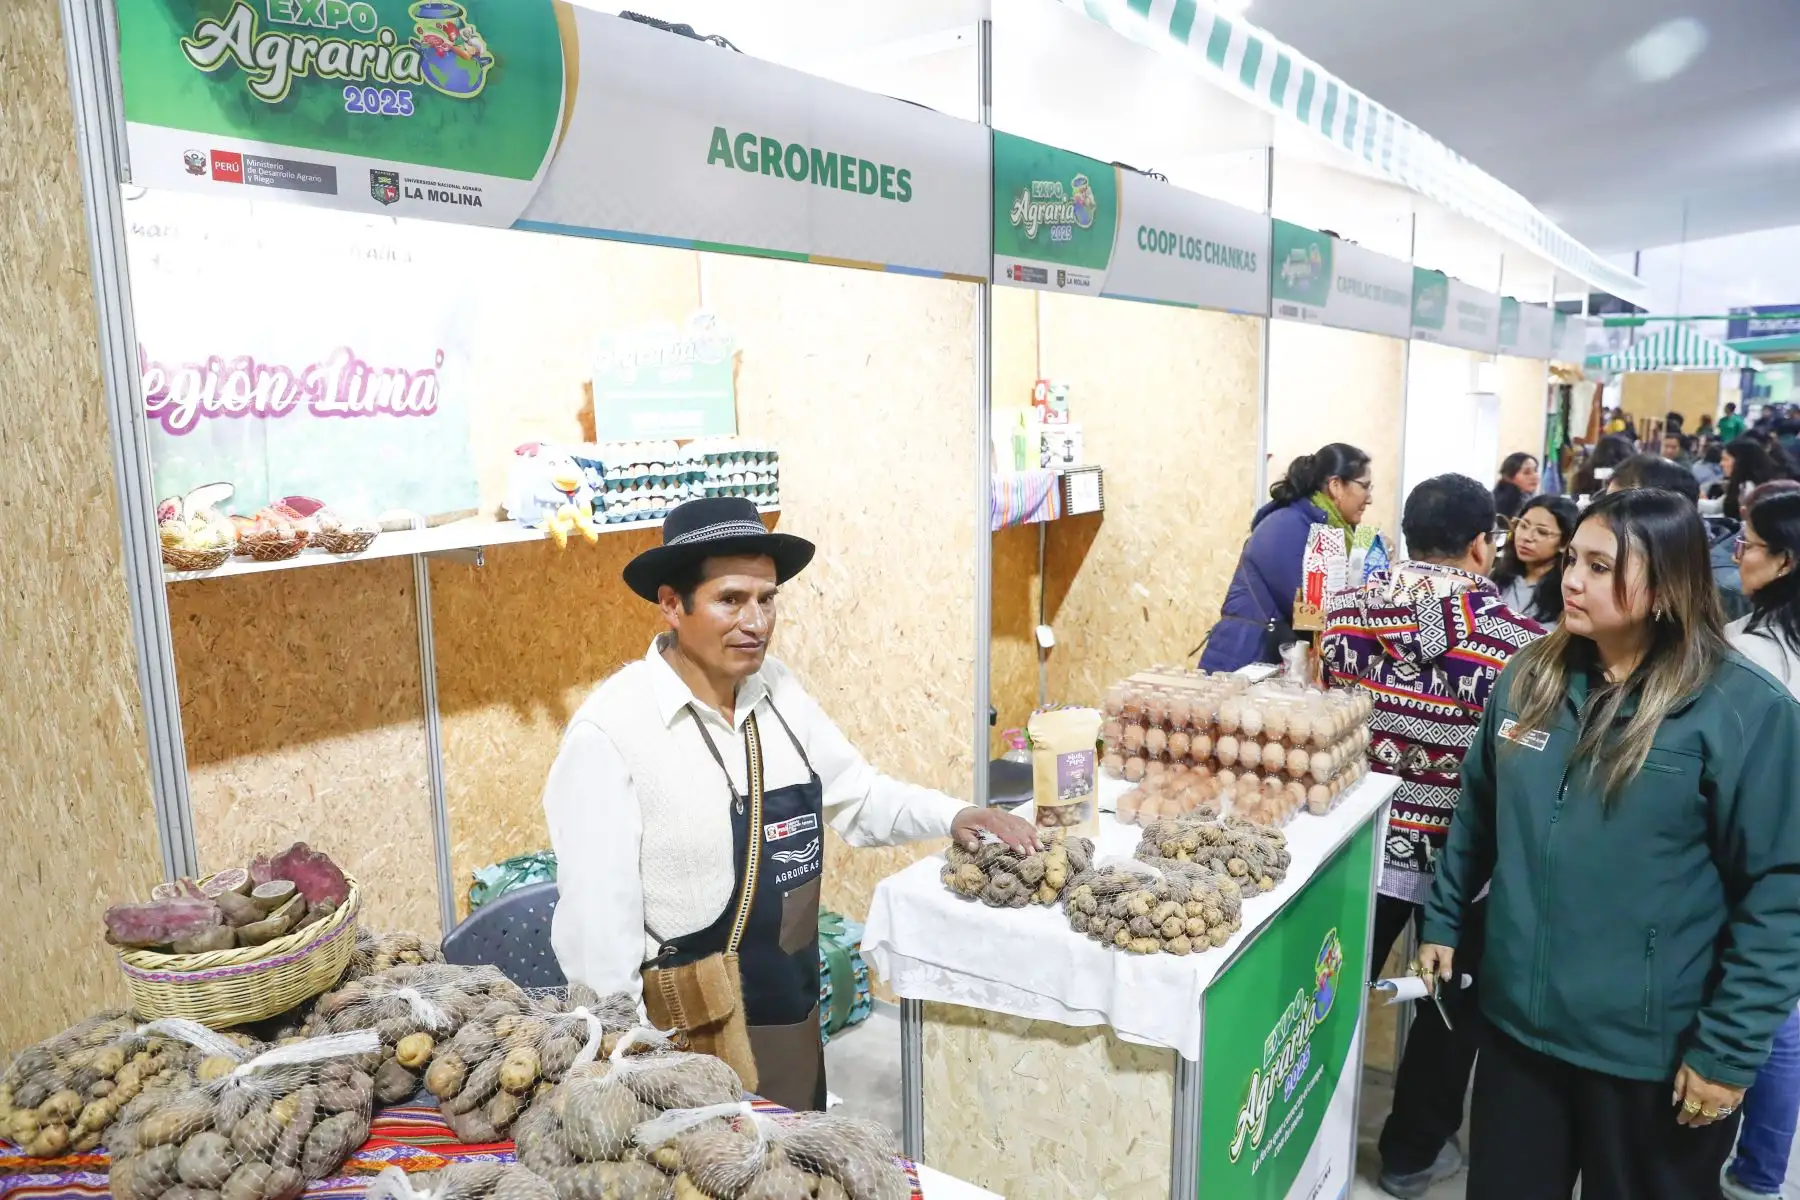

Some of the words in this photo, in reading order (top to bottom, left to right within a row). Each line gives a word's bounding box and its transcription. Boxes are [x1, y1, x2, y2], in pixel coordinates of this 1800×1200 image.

[267, 0, 378, 32] EXPO
[181, 2, 422, 102] Agraria
[344, 87, 414, 116] 2025
[214, 161, 240, 172] PERÚ
[246, 159, 284, 170] Ministerio
[258, 168, 296, 179] Desarrollo
[707, 126, 912, 203] AGROMEDES
[254, 175, 275, 184] Riego
[404, 177, 437, 187] UNIVERSIDAD
[437, 181, 461, 190] NACIONAL
[1031, 181, 1063, 198] EXPO
[404, 186, 424, 200] LA
[427, 189, 483, 207] MOLINA
[1010, 187, 1075, 240] Agraria
[1138, 225, 1177, 256] COOP
[1179, 234, 1202, 262] LOS
[1204, 240, 1257, 272] CHANKAS
[139, 355, 298, 436] egión
[775, 860, 819, 884] AGROIDEAS
[1263, 988, 1304, 1070] EXPO
[1229, 996, 1316, 1163] Agraria
